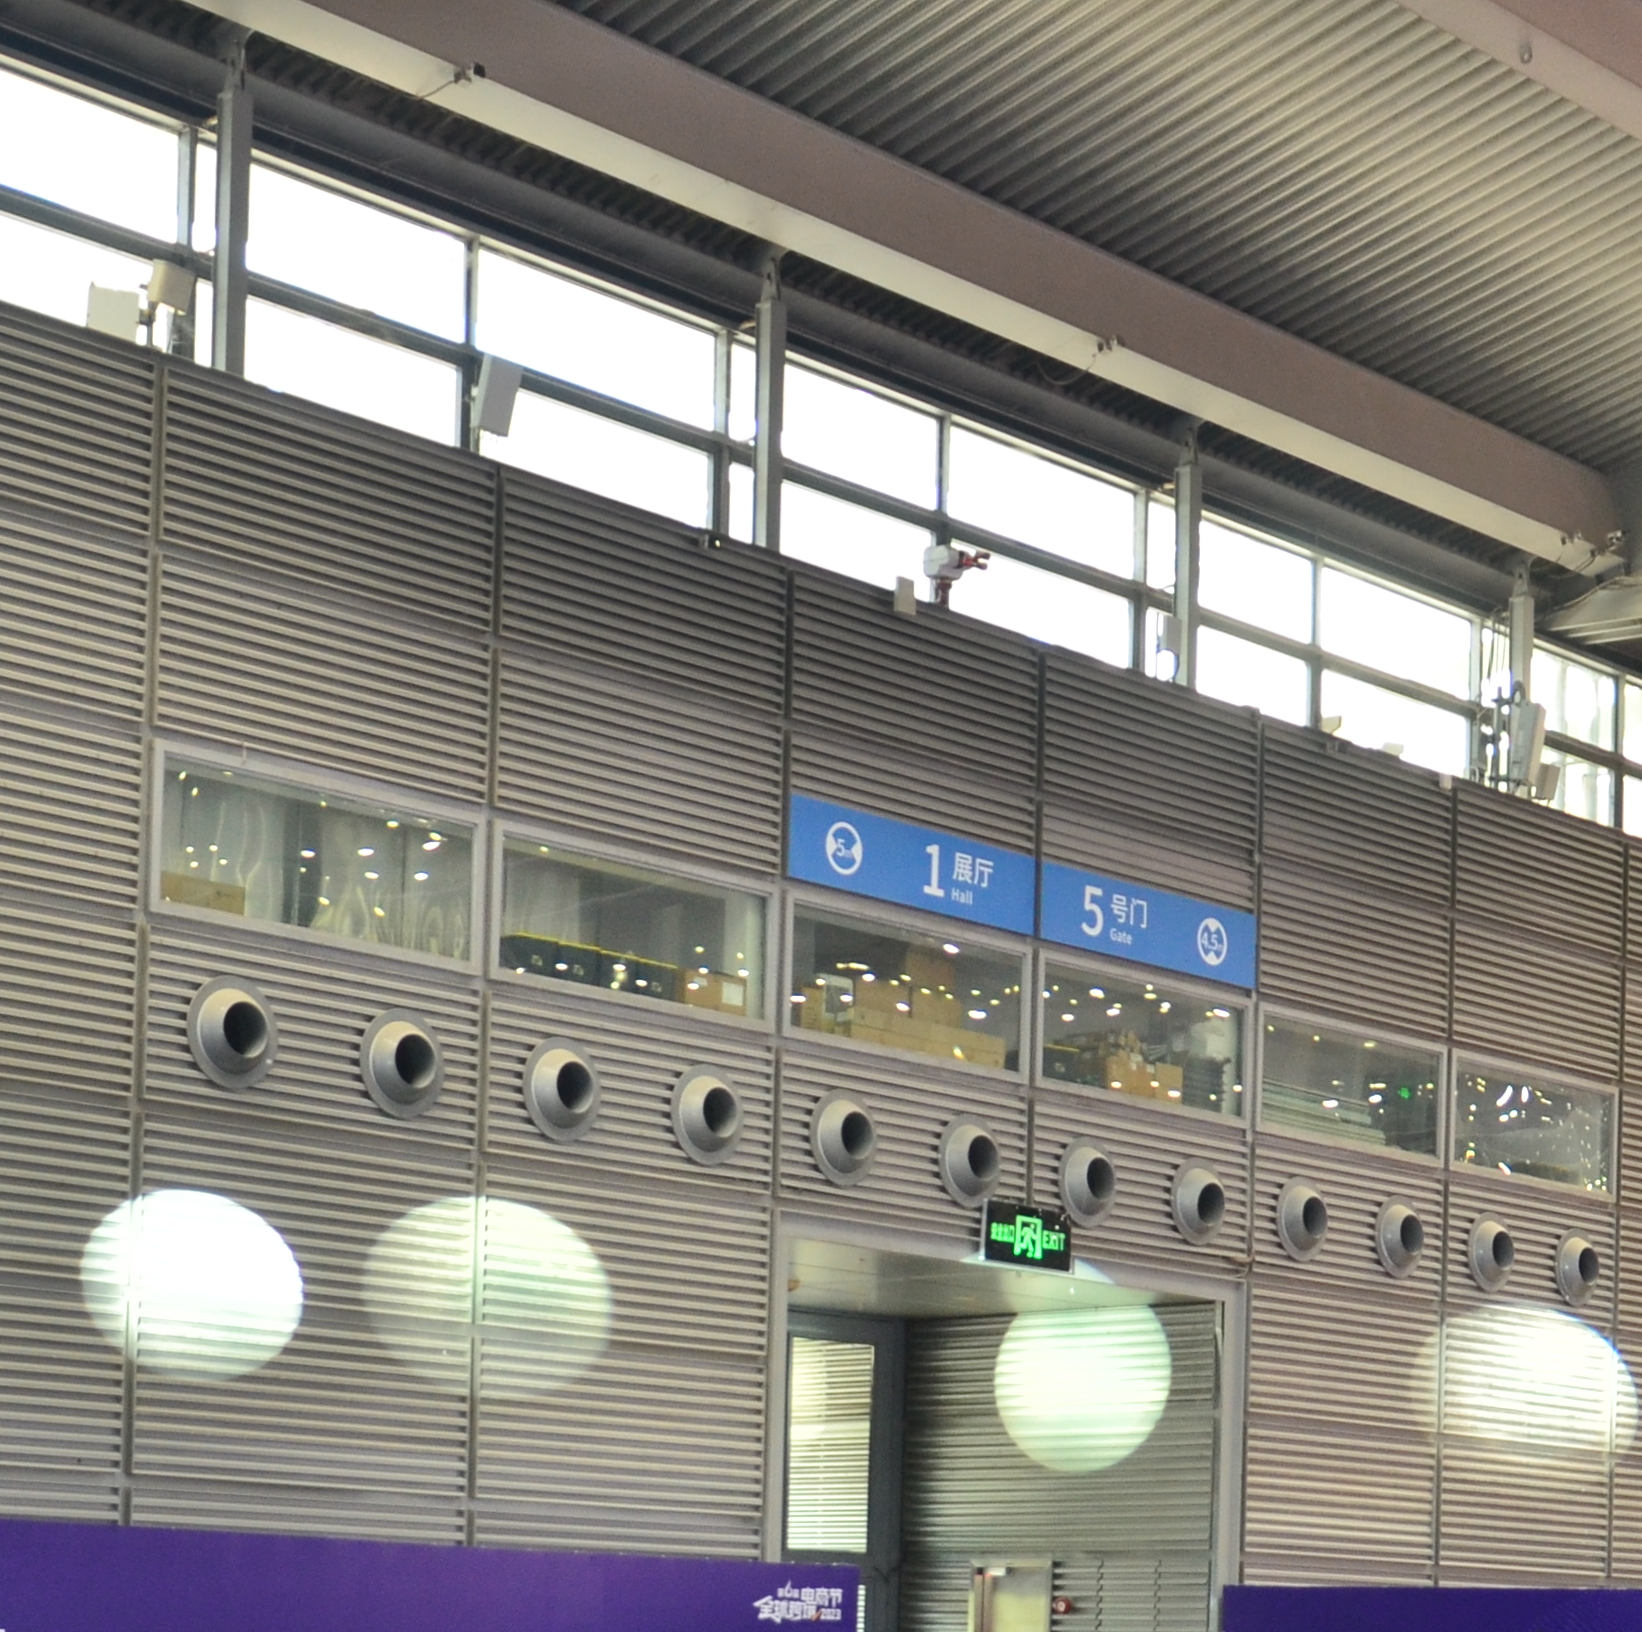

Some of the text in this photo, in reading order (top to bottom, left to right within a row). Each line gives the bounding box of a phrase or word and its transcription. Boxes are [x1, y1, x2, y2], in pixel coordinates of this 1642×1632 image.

[922, 843, 995, 898] 1 展厅
[951, 887, 974, 906] Hall
[1081, 885, 1148, 937] 5 号门
[1109, 926, 1133, 946] Gate
[1042, 1229, 1066, 1251] EXIT
[800, 1586, 844, 1608] 电商节
